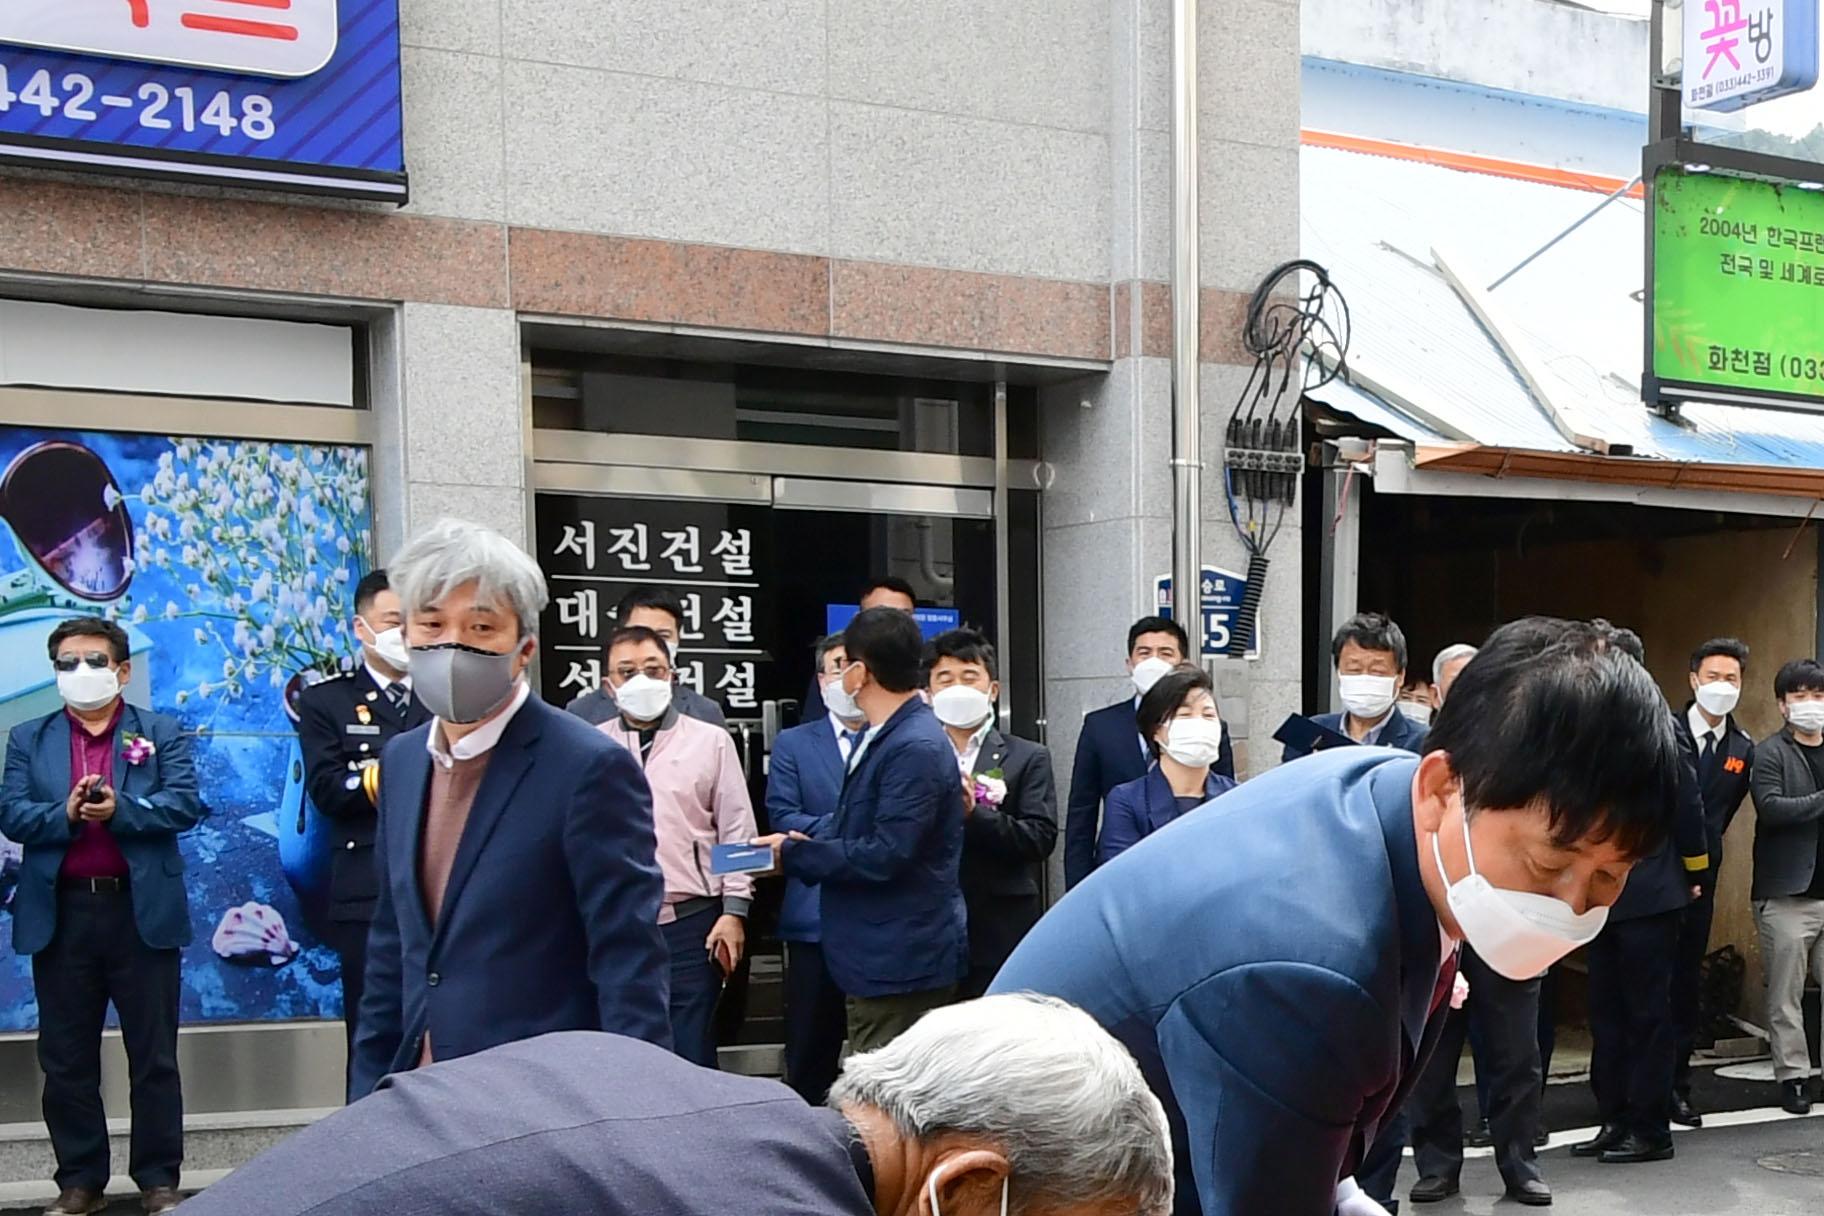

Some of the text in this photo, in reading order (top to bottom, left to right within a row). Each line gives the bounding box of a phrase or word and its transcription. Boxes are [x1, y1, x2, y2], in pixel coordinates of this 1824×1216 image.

[1700, 216, 1757, 244] 2004년
[1720, 253, 1753, 277] 전국
[1759, 258, 1774, 280] 및
[1708, 345, 1771, 377] 화천점
[554, 521, 754, 575] 서진건설
